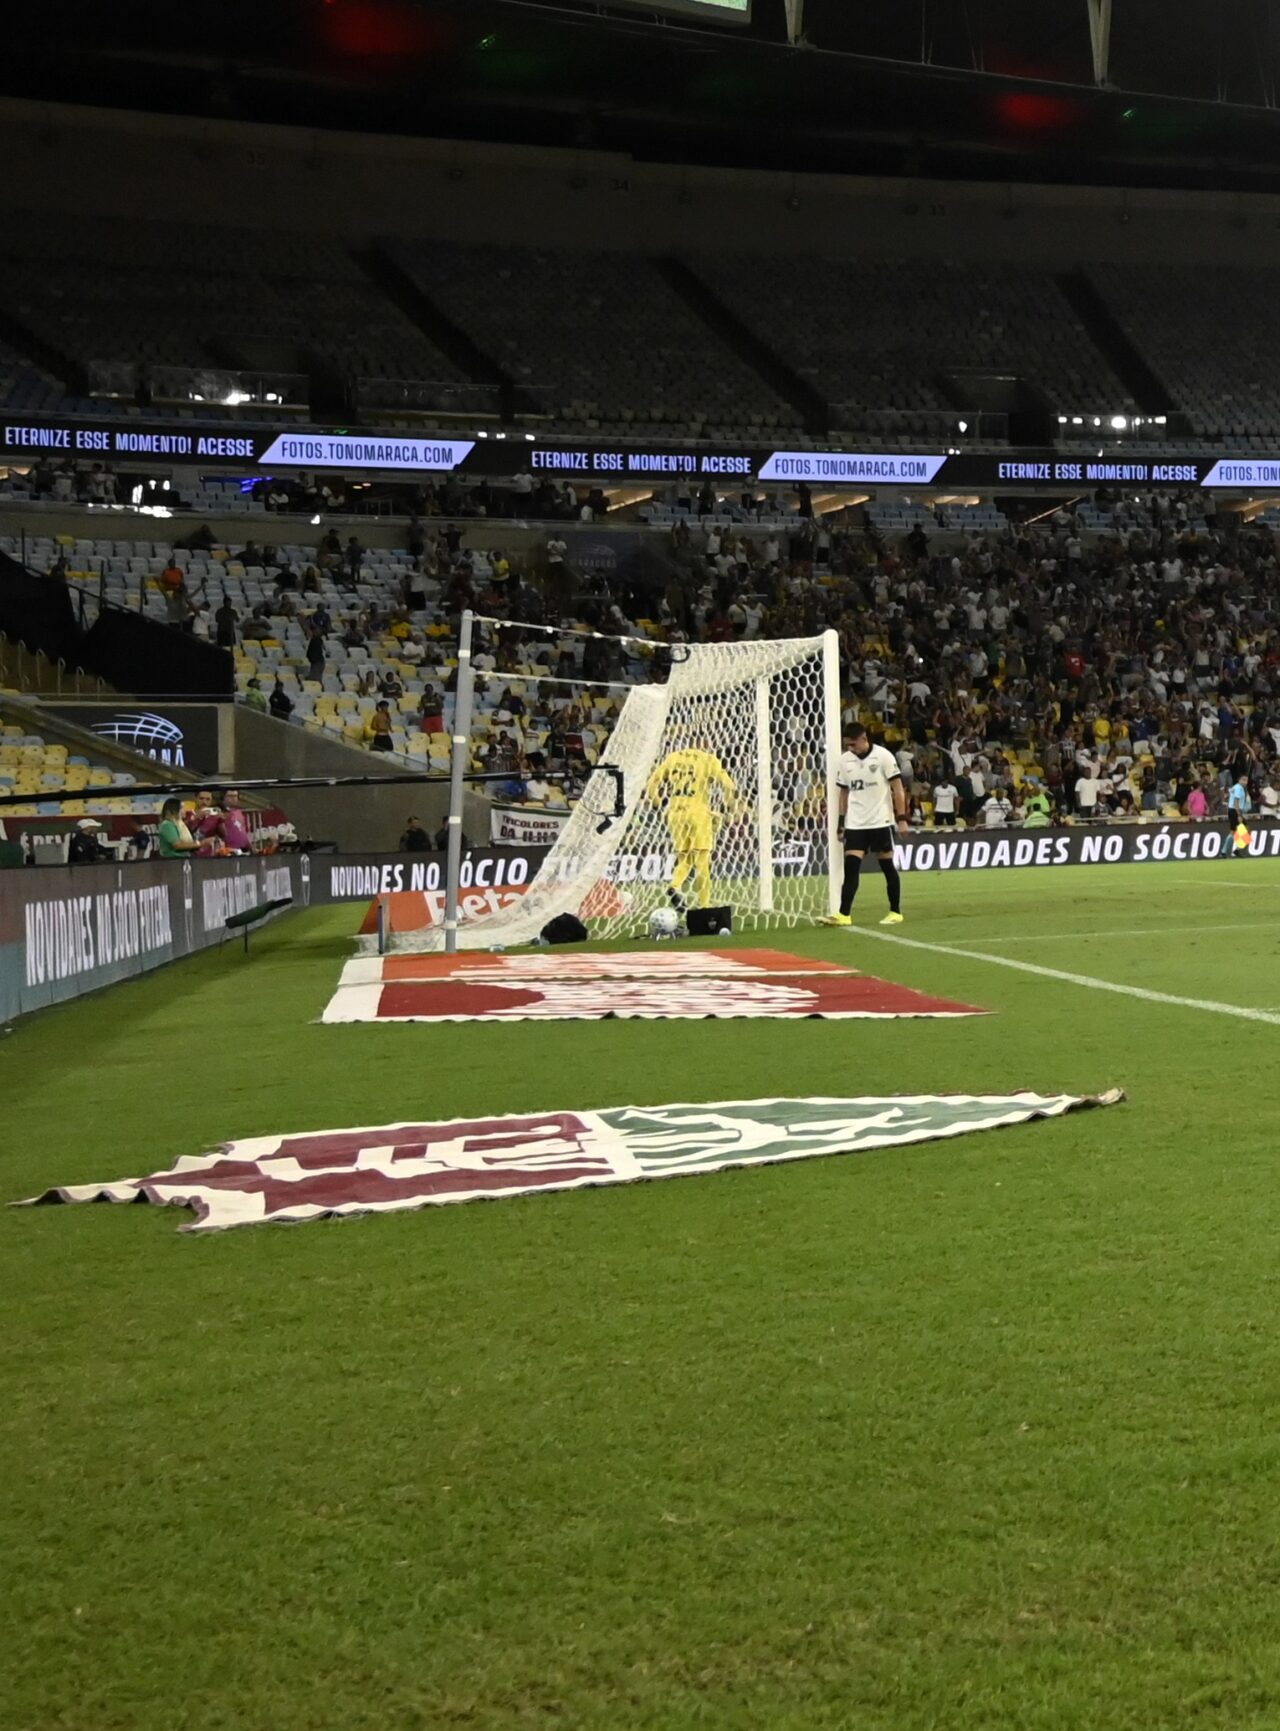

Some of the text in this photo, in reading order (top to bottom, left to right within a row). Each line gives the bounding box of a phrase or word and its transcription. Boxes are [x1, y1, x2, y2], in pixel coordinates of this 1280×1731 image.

[613, 180, 629, 191] 34
[5, 427, 254, 457] ETERNIZE ESSE MOMENTO! ACESSE
[281, 441, 453, 464] FOTOS.TONOMARACA.COM
[531, 451, 751, 473] ETERNIZE ESSE MOMENTO! ACESSE
[775, 458, 927, 477] FOTOS.TONOMARACA.COM
[999, 463, 1197, 481] ETERNIZE ESSE MOMENTO! ACESSE
[500, 825, 517, 841] DA
[893, 837, 1070, 871] NOVIDADES
[1080, 835, 1123, 863] NO
[1133, 825, 1220, 861] SÓCIO
[331, 863, 404, 897] NOVIDADES
[411, 862, 440, 891] NO
[459, 851, 528, 889] ÓCIO
[26, 896, 94, 987] NOVIDADES
